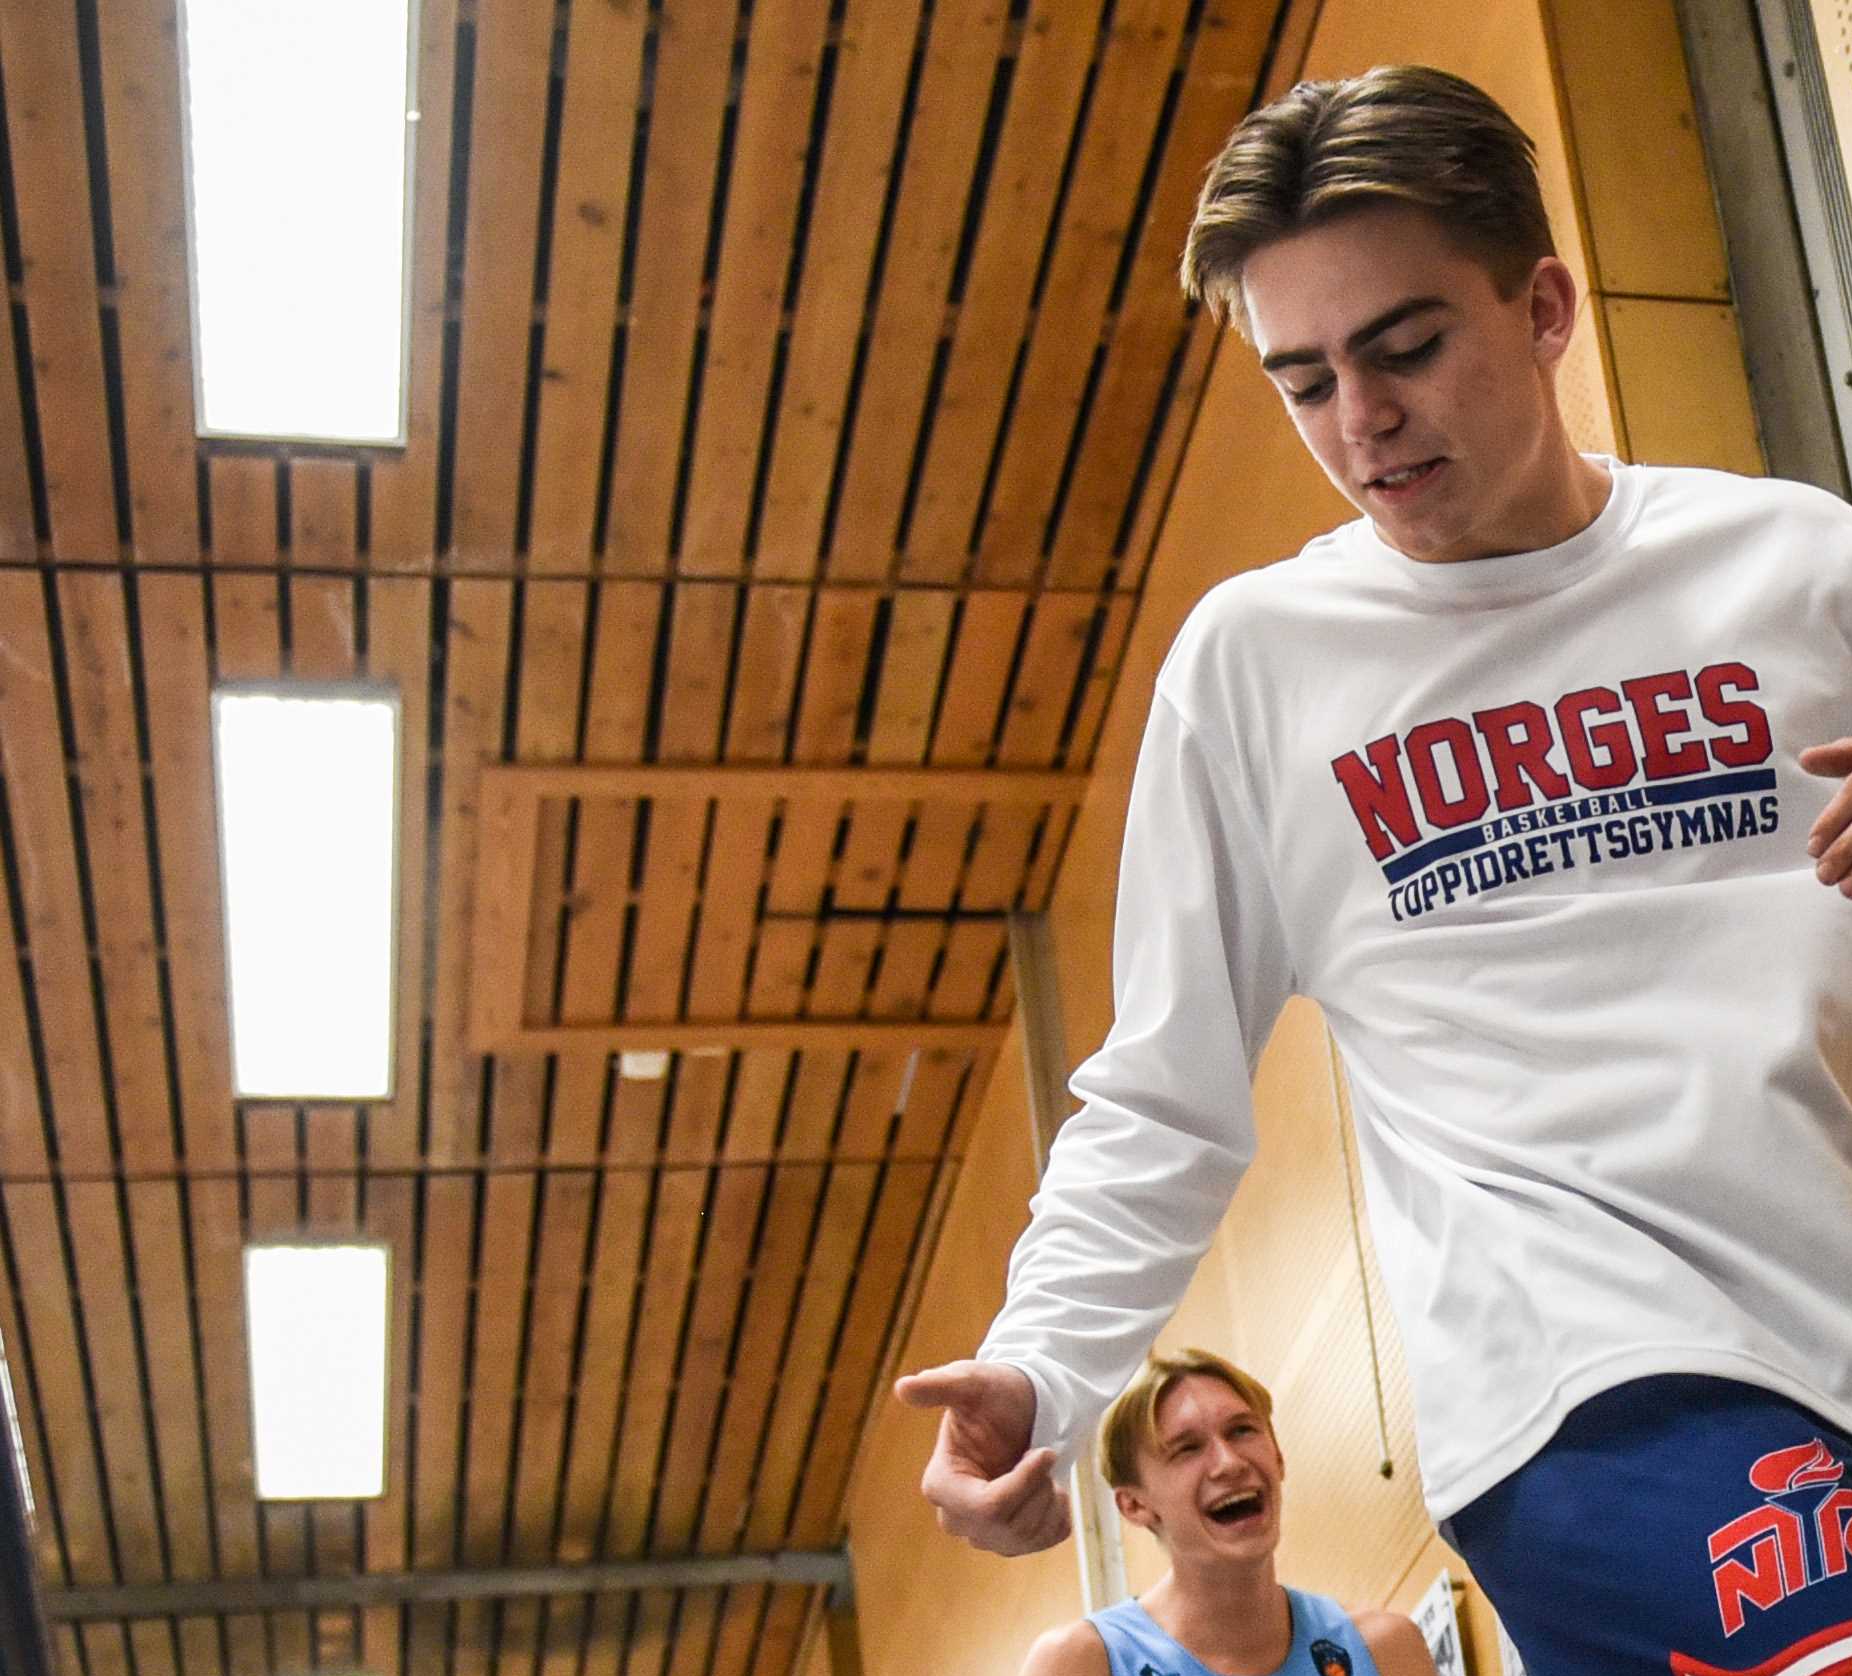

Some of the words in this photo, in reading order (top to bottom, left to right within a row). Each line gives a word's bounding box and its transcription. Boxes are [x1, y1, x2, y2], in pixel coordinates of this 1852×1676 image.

[1331, 661, 1774, 862] NORGES
[1481, 787, 1654, 844] BASKETBALL
[1387, 796, 1779, 922] TOPPIDRETTSGYMNAS
